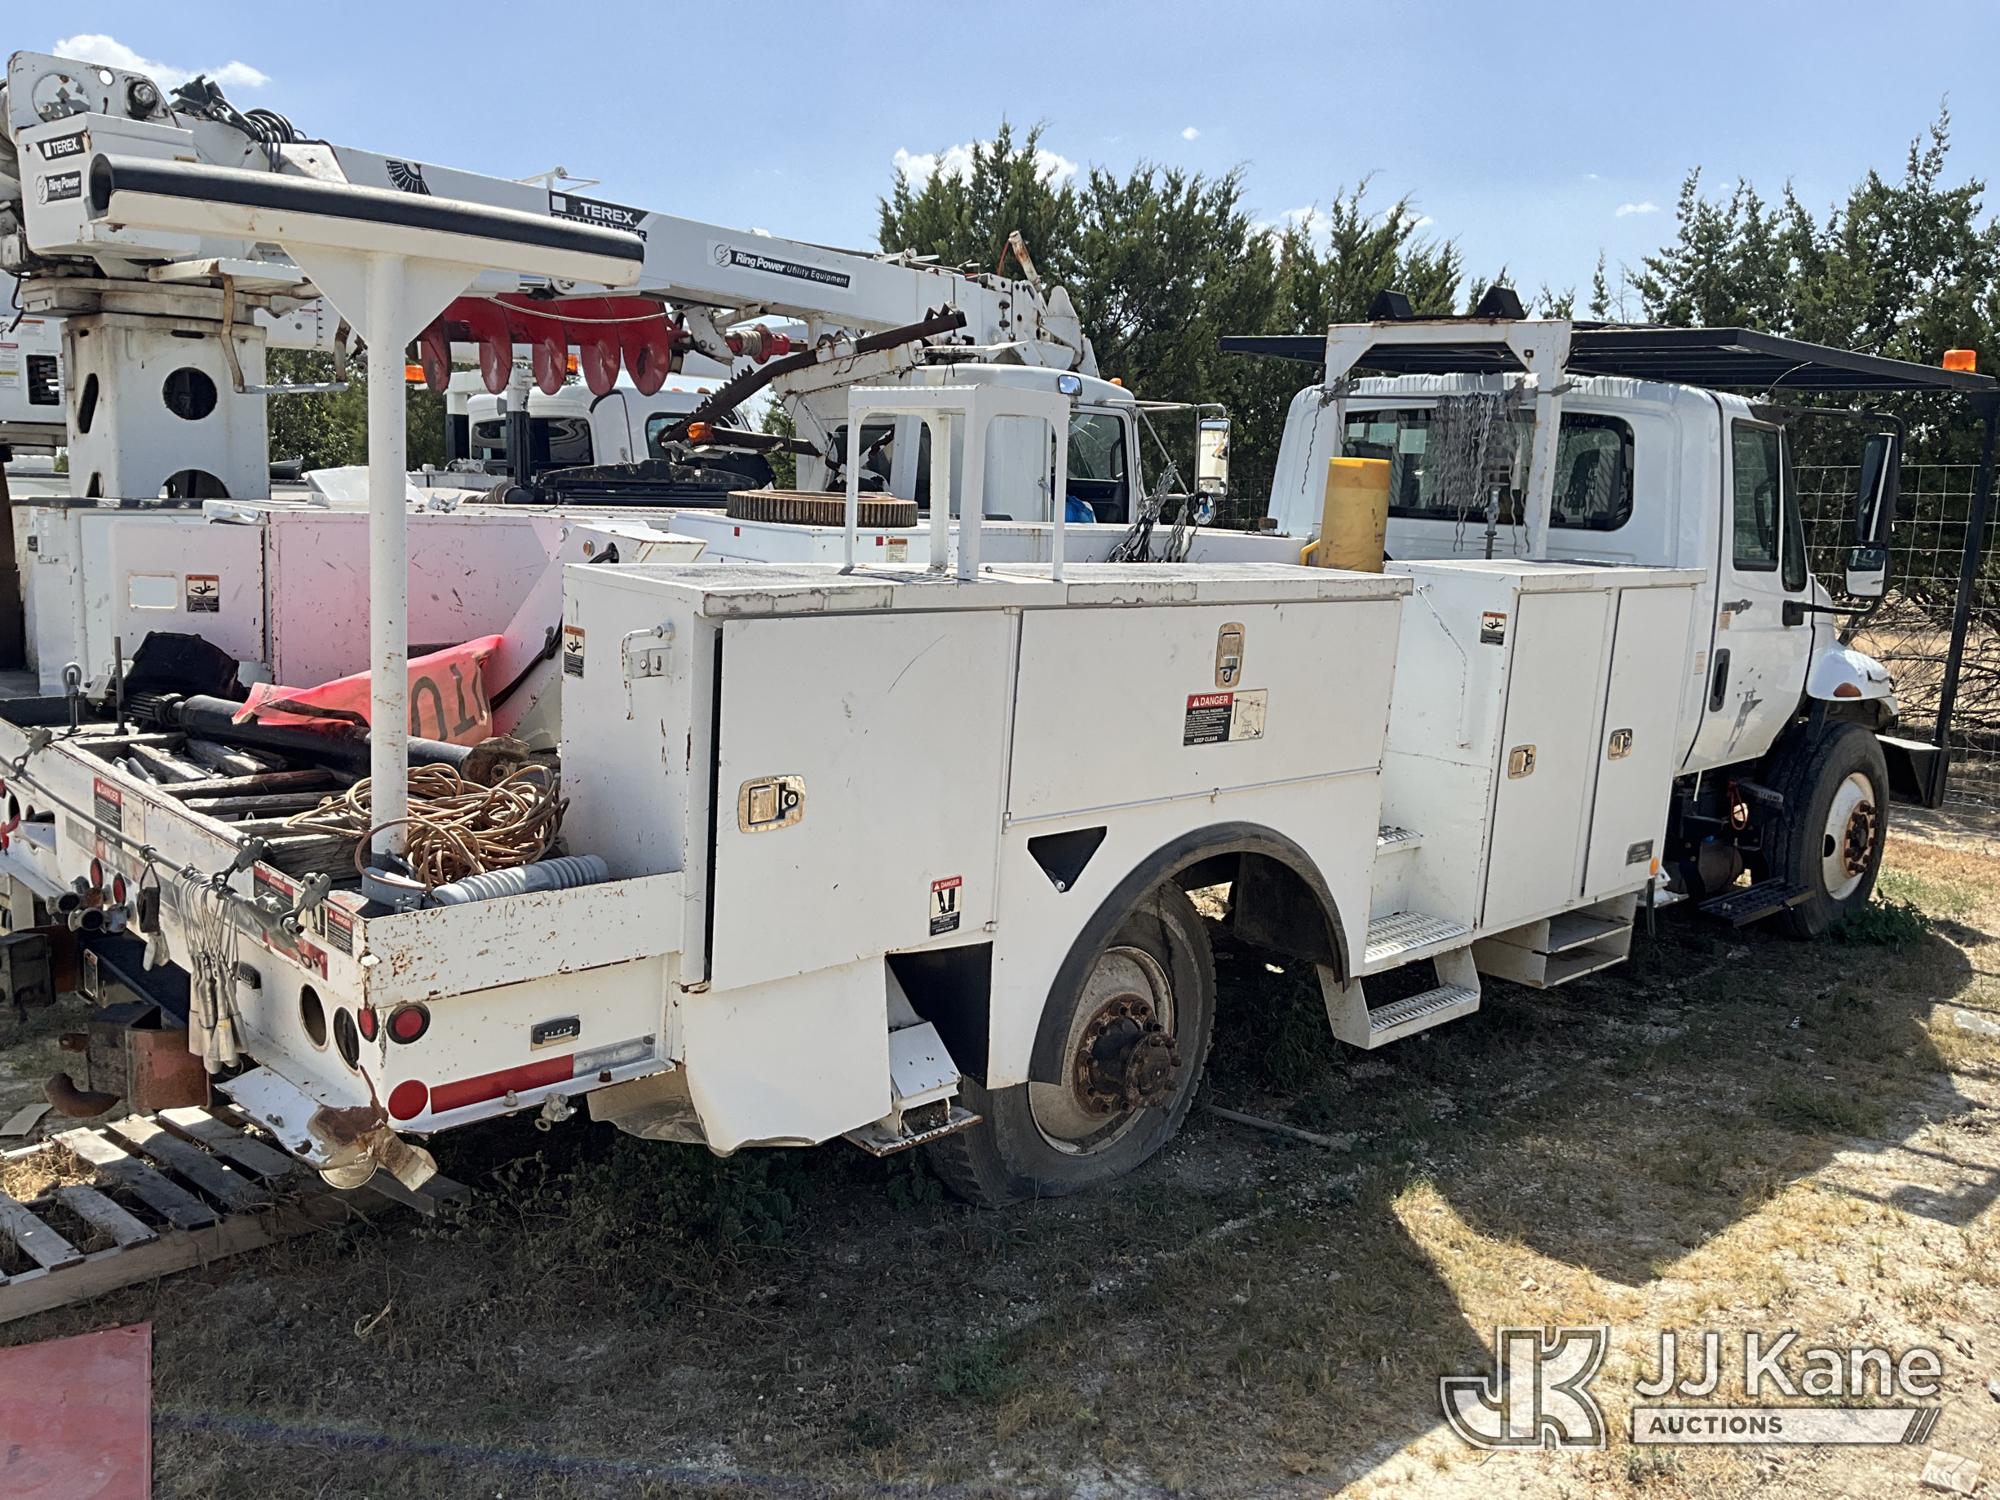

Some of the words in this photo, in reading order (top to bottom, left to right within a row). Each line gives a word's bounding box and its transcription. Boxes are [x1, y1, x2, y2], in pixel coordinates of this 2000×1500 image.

[51, 137, 79, 155] TEREX
[580, 202, 634, 225] TEREX
[735, 252, 756, 269] Ring
[756, 257, 787, 273] Power
[786, 264, 809, 278] Utility
[810, 270, 848, 285] Equipment
[1200, 695, 1229, 706] DANGER
[940, 878, 960, 888] DANGER
